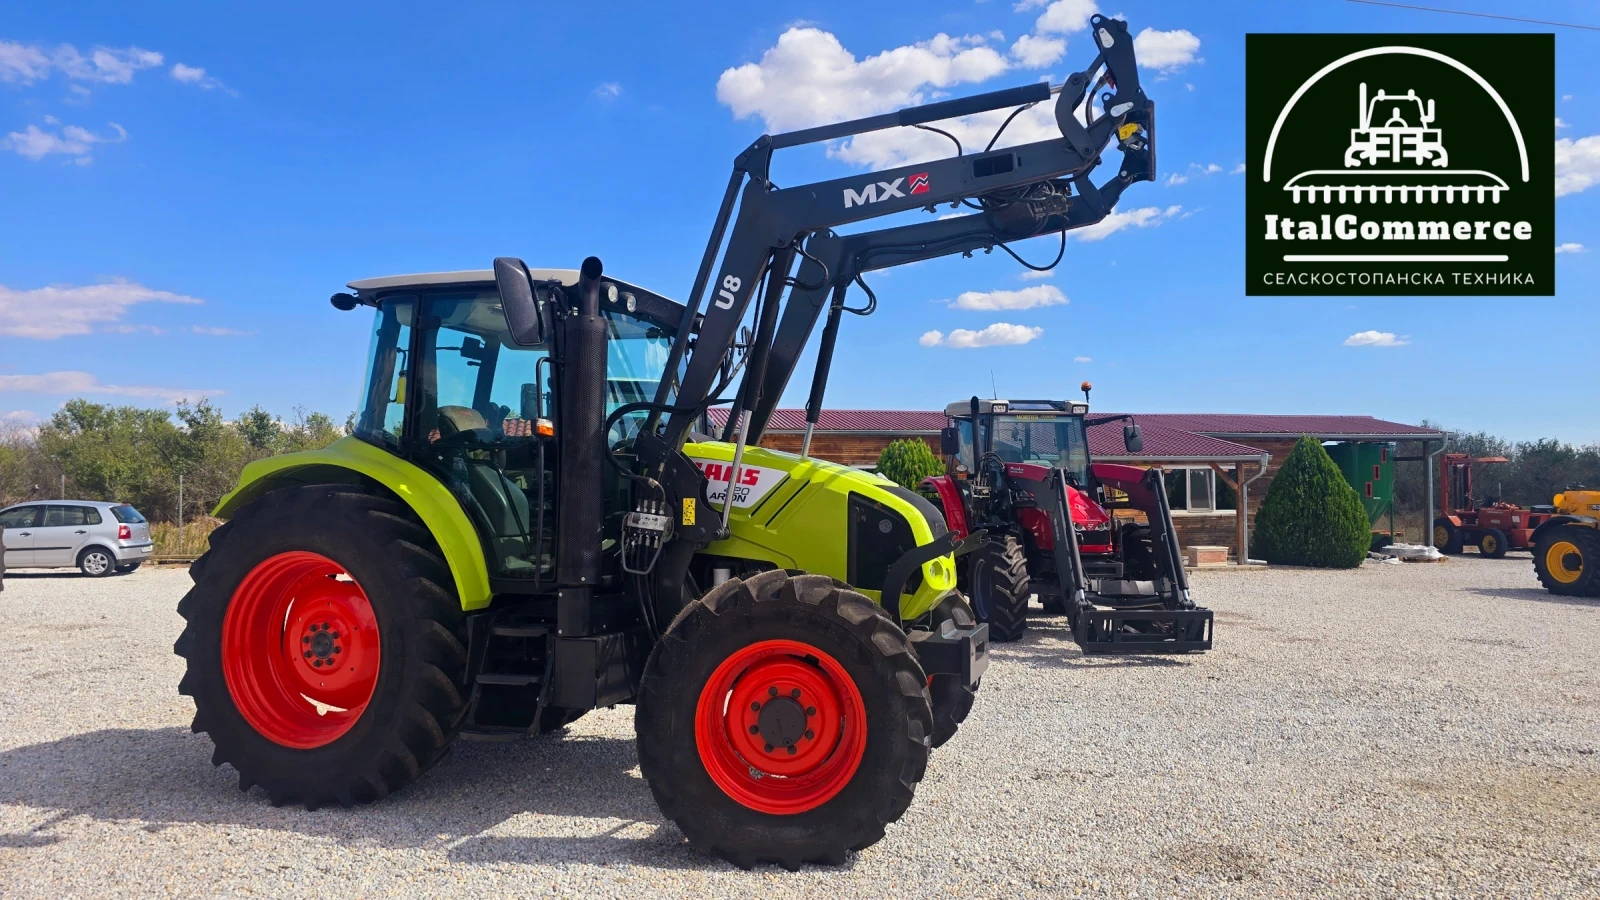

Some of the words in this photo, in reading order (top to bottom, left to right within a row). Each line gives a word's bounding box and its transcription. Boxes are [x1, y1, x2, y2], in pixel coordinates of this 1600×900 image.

[843, 177, 906, 208] MX
[715, 275, 741, 310] U8
[709, 492, 747, 503] ARON
[724, 486, 750, 496] 20
